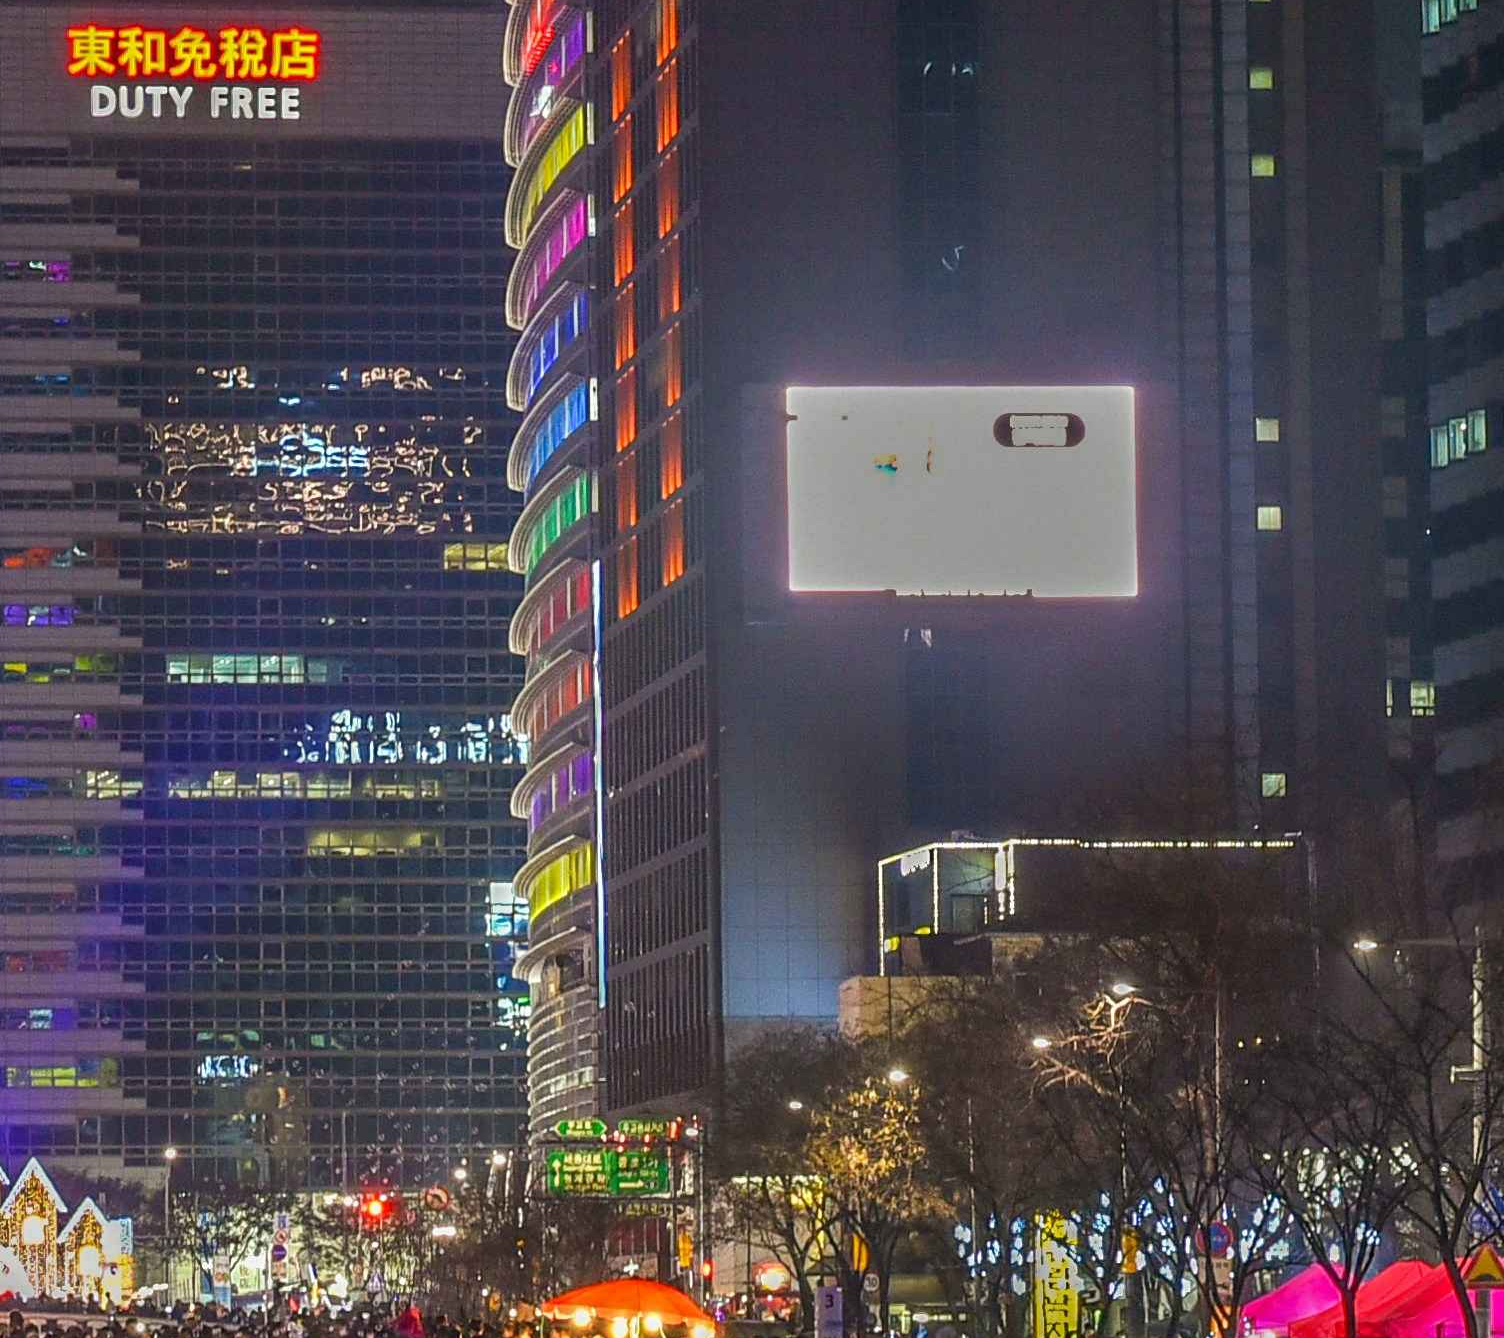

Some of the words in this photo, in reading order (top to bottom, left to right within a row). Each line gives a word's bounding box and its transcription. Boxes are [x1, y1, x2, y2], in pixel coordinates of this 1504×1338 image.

[69, 27, 318, 78] 東和免稅店
[91, 85, 192, 118] DUTY
[211, 85, 300, 120] FREE
